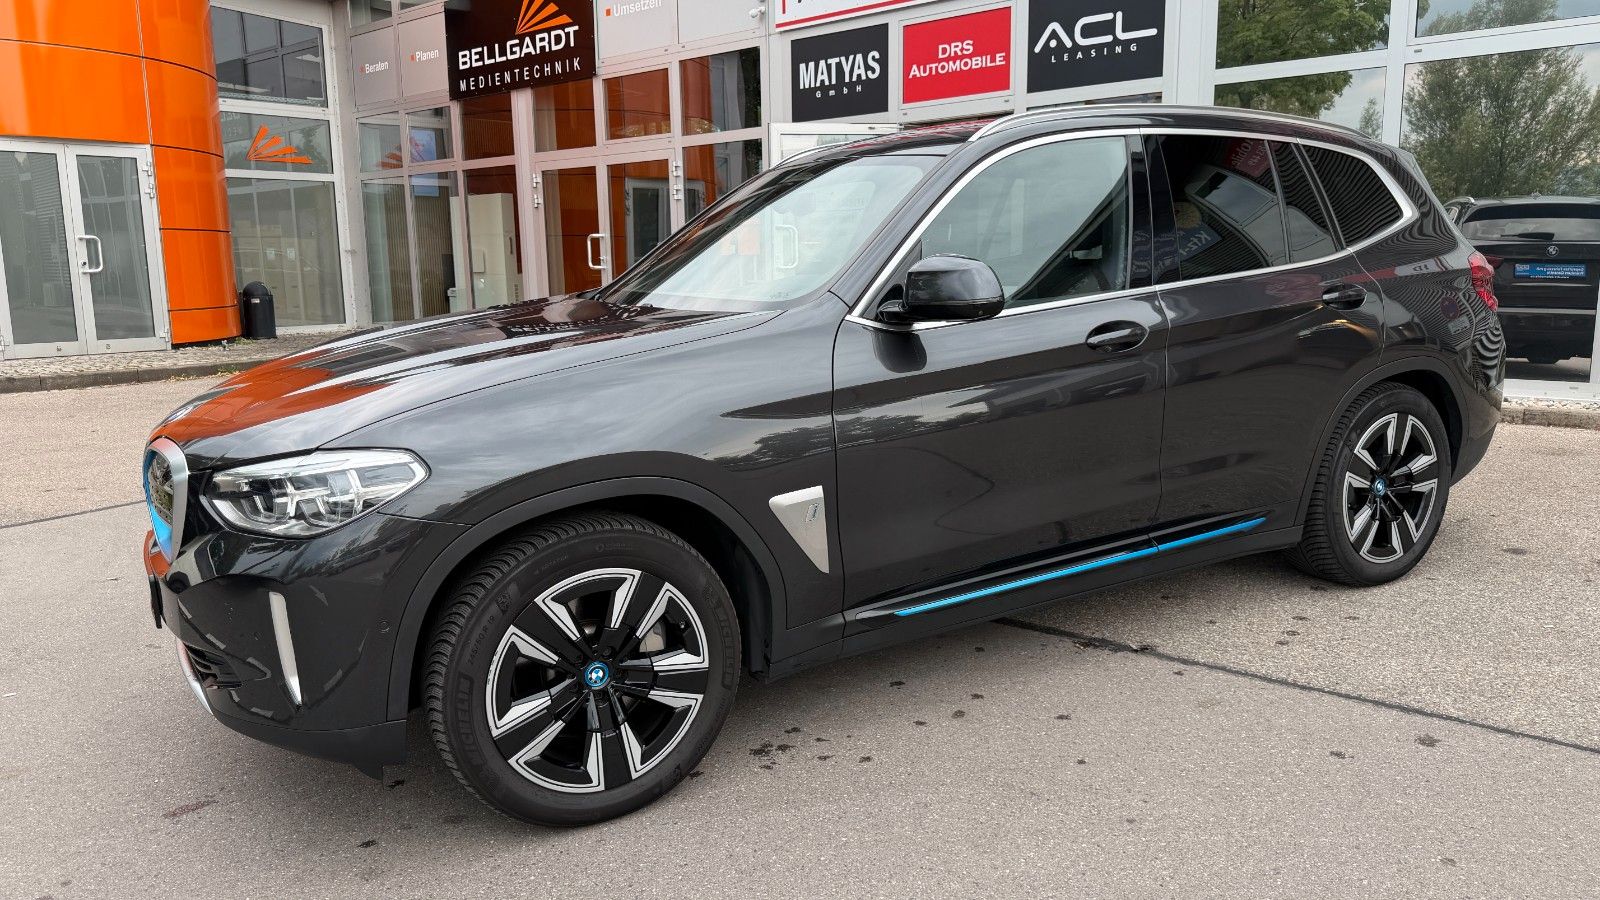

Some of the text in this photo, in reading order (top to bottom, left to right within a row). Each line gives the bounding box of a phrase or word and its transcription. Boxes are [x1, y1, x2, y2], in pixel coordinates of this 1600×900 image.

[613, 0, 662, 17] Umsetzen
[1034, 10, 1158, 54] ACL
[415, 49, 439, 62] Planen
[458, 25, 579, 70] BELLGARDT
[937, 40, 974, 58] DRS
[1050, 42, 1138, 64] LEASING
[365, 61, 389, 74] Beraten
[459, 56, 582, 93] MEDIENTECHNIK
[799, 50, 881, 90] MATYAS
[908, 52, 1006, 79] AUTOMOBILE
